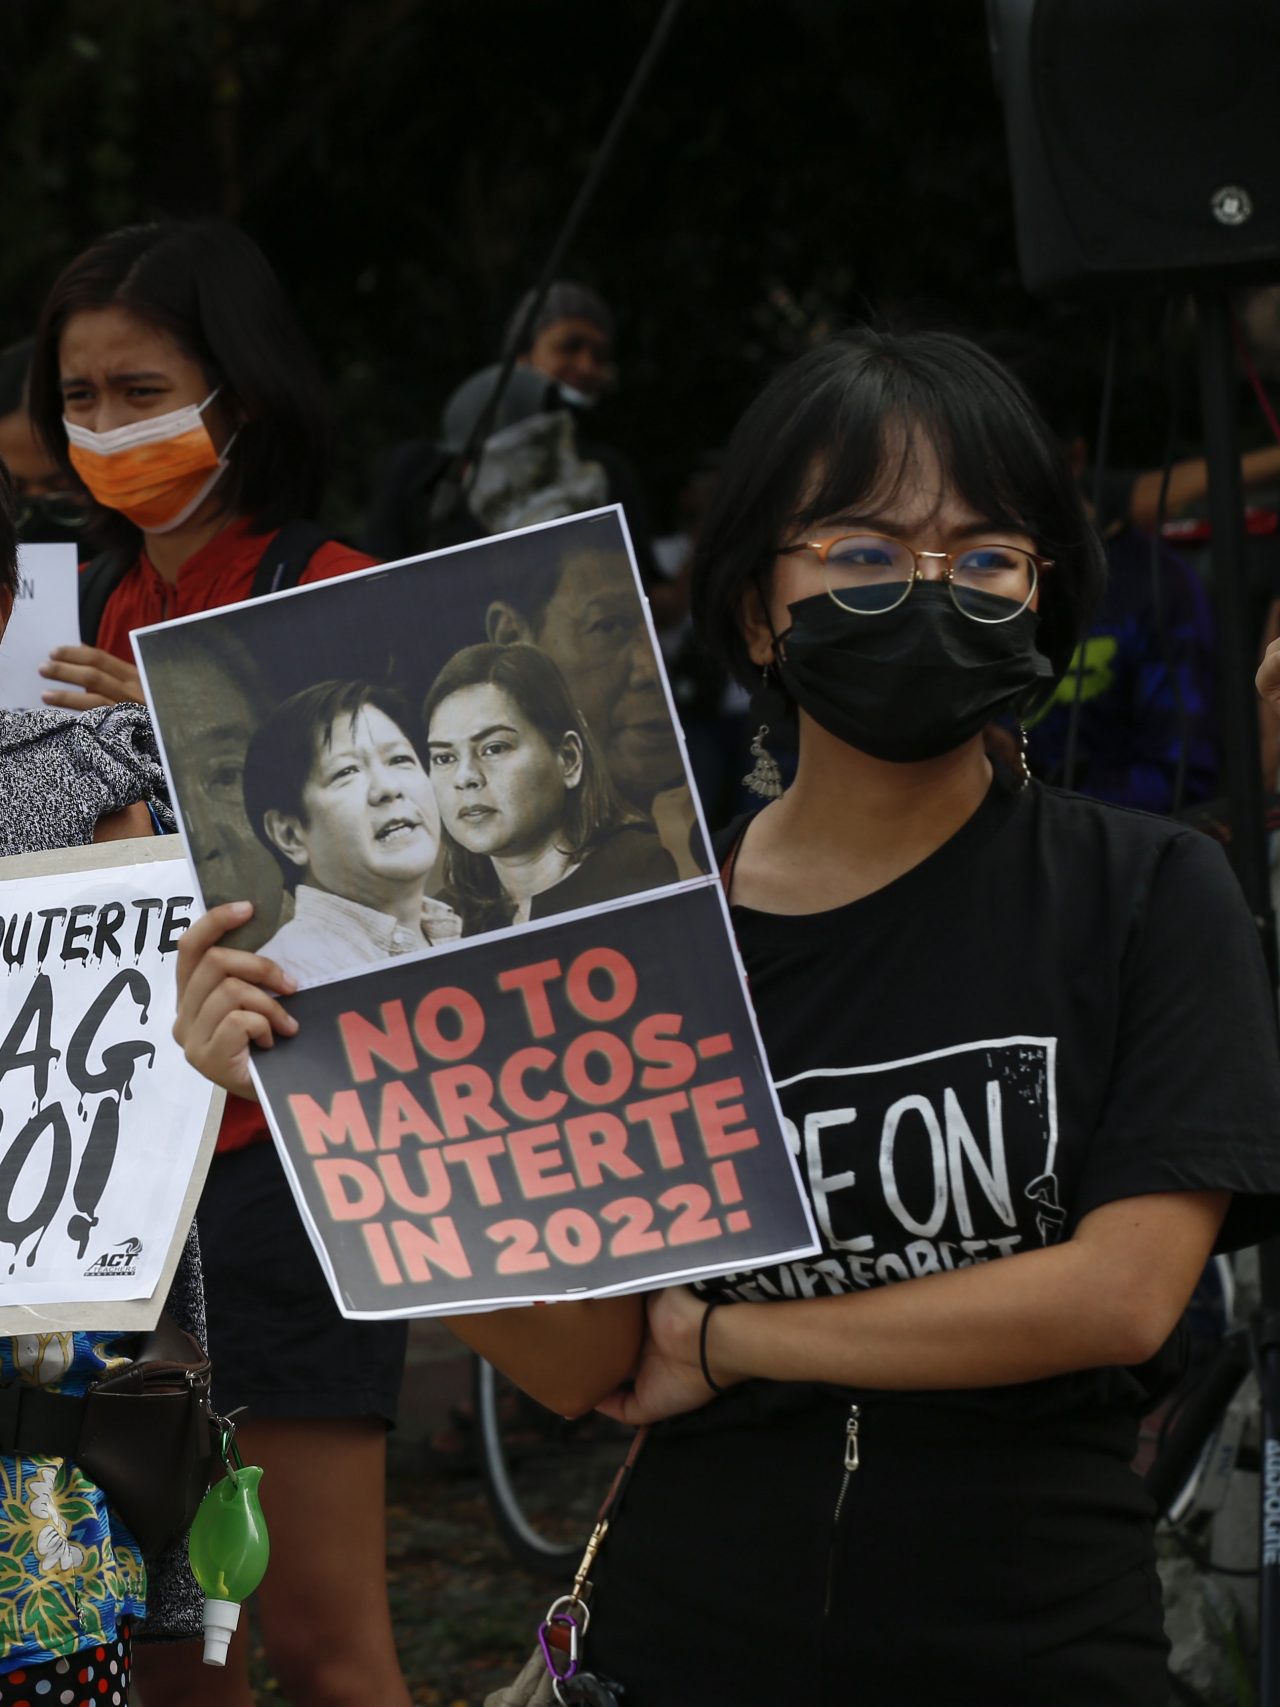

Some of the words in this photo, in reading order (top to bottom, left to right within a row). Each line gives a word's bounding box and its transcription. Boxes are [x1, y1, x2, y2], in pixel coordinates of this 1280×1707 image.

[287, 1013, 734, 1156] MARCOS-
[337, 986, 486, 1083] NO
[498, 946, 638, 1039] TO
[312, 1076, 760, 1222] DUTERTE
[879, 1080, 1017, 1239] ON
[87, 1253, 138, 1271] ACT
[361, 1216, 473, 1286] IN
[485, 1160, 752, 1275] 2022!
